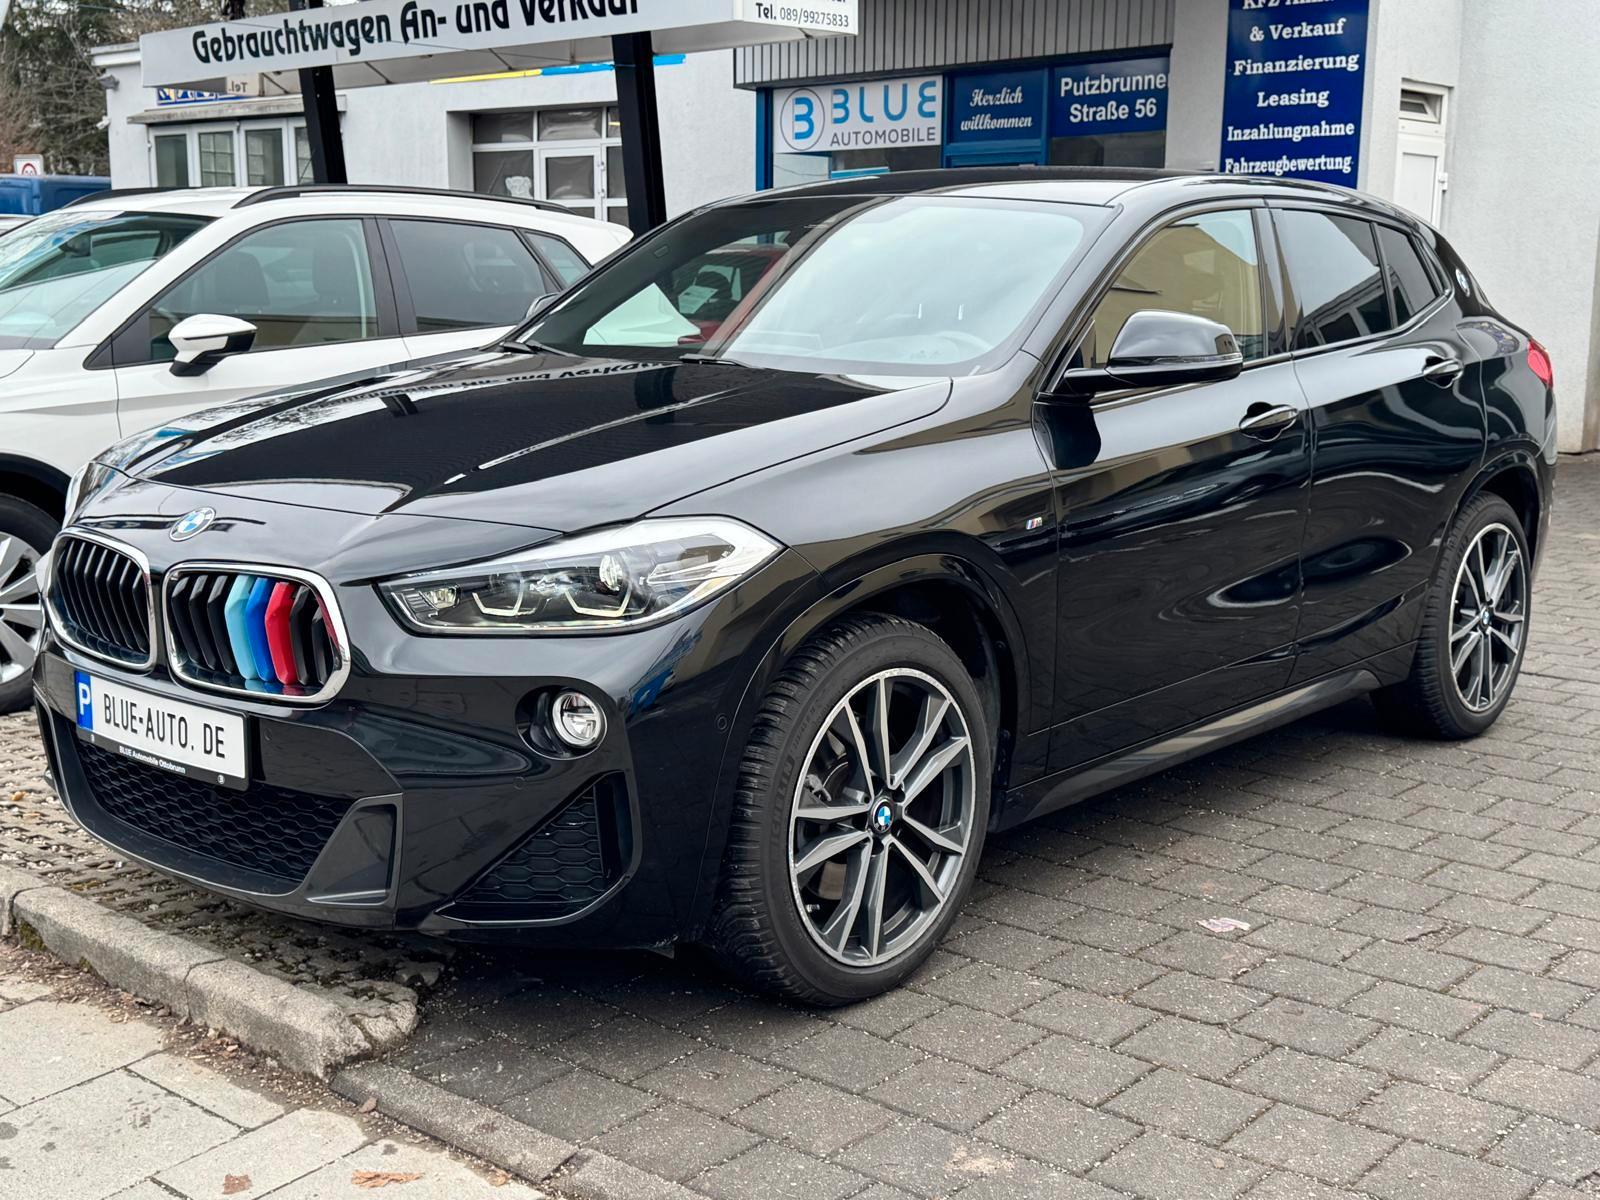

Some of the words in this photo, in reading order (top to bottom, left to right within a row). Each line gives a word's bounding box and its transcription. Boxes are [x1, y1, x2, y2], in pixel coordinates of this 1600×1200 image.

[755, 2, 777, 20] Tel.
[780, 7, 849, 28] 089/99275833
[192, 14, 392, 64] Gebrauchtwagen
[400, 1, 447, 45] An-
[456, 0, 510, 34] und
[1249, 26, 1265, 42] &
[1269, 17, 1347, 40] Verkauf
[1233, 54, 1360, 76] Finanzierung
[969, 86, 1024, 107] Herzlich
[1060, 73, 1170, 98] Putzbrunne
[1256, 88, 1330, 108] Leasing
[831, 80, 937, 125] BLUE
[1069, 101, 1130, 124] Straße
[1134, 97, 1158, 118] 56
[960, 114, 1033, 132] willkommen
[1227, 120, 1355, 143] Inzahlungnahme
[829, 126, 936, 147] AUTOMOBILE
[1225, 155, 1353, 176] Fahrzeugbewertung
[78, 683, 91, 716] P
[203, 722, 226, 759] DE
